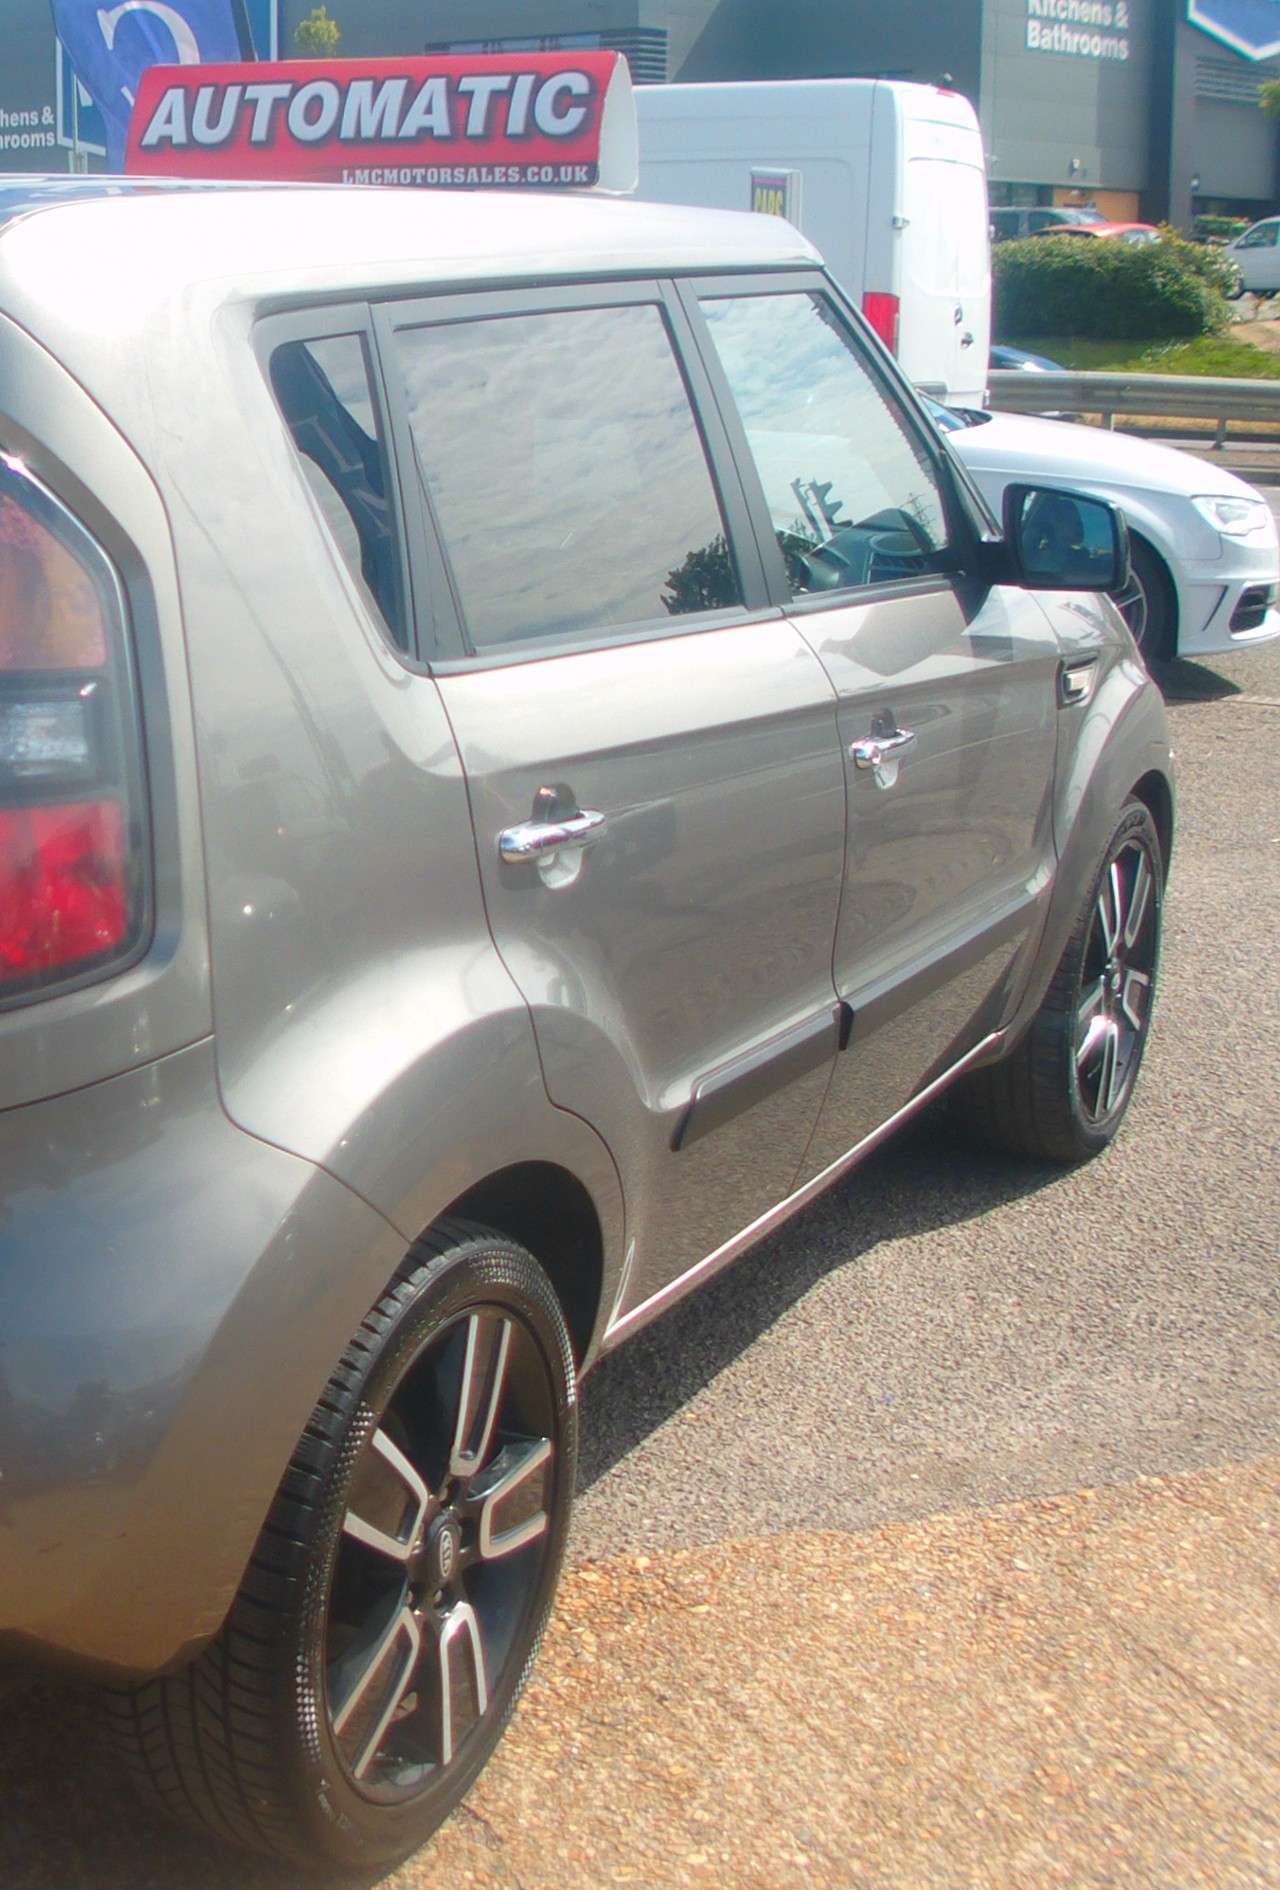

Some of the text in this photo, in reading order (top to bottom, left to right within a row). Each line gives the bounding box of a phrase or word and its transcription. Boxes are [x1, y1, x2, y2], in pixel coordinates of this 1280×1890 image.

[1026, 19, 1129, 60] Bathrooms
[42, 105, 55, 125] &
[140, 71, 589, 147] AUTOMATIC
[342, 165, 589, 185] LMCMOTORSALES.CO.UK
